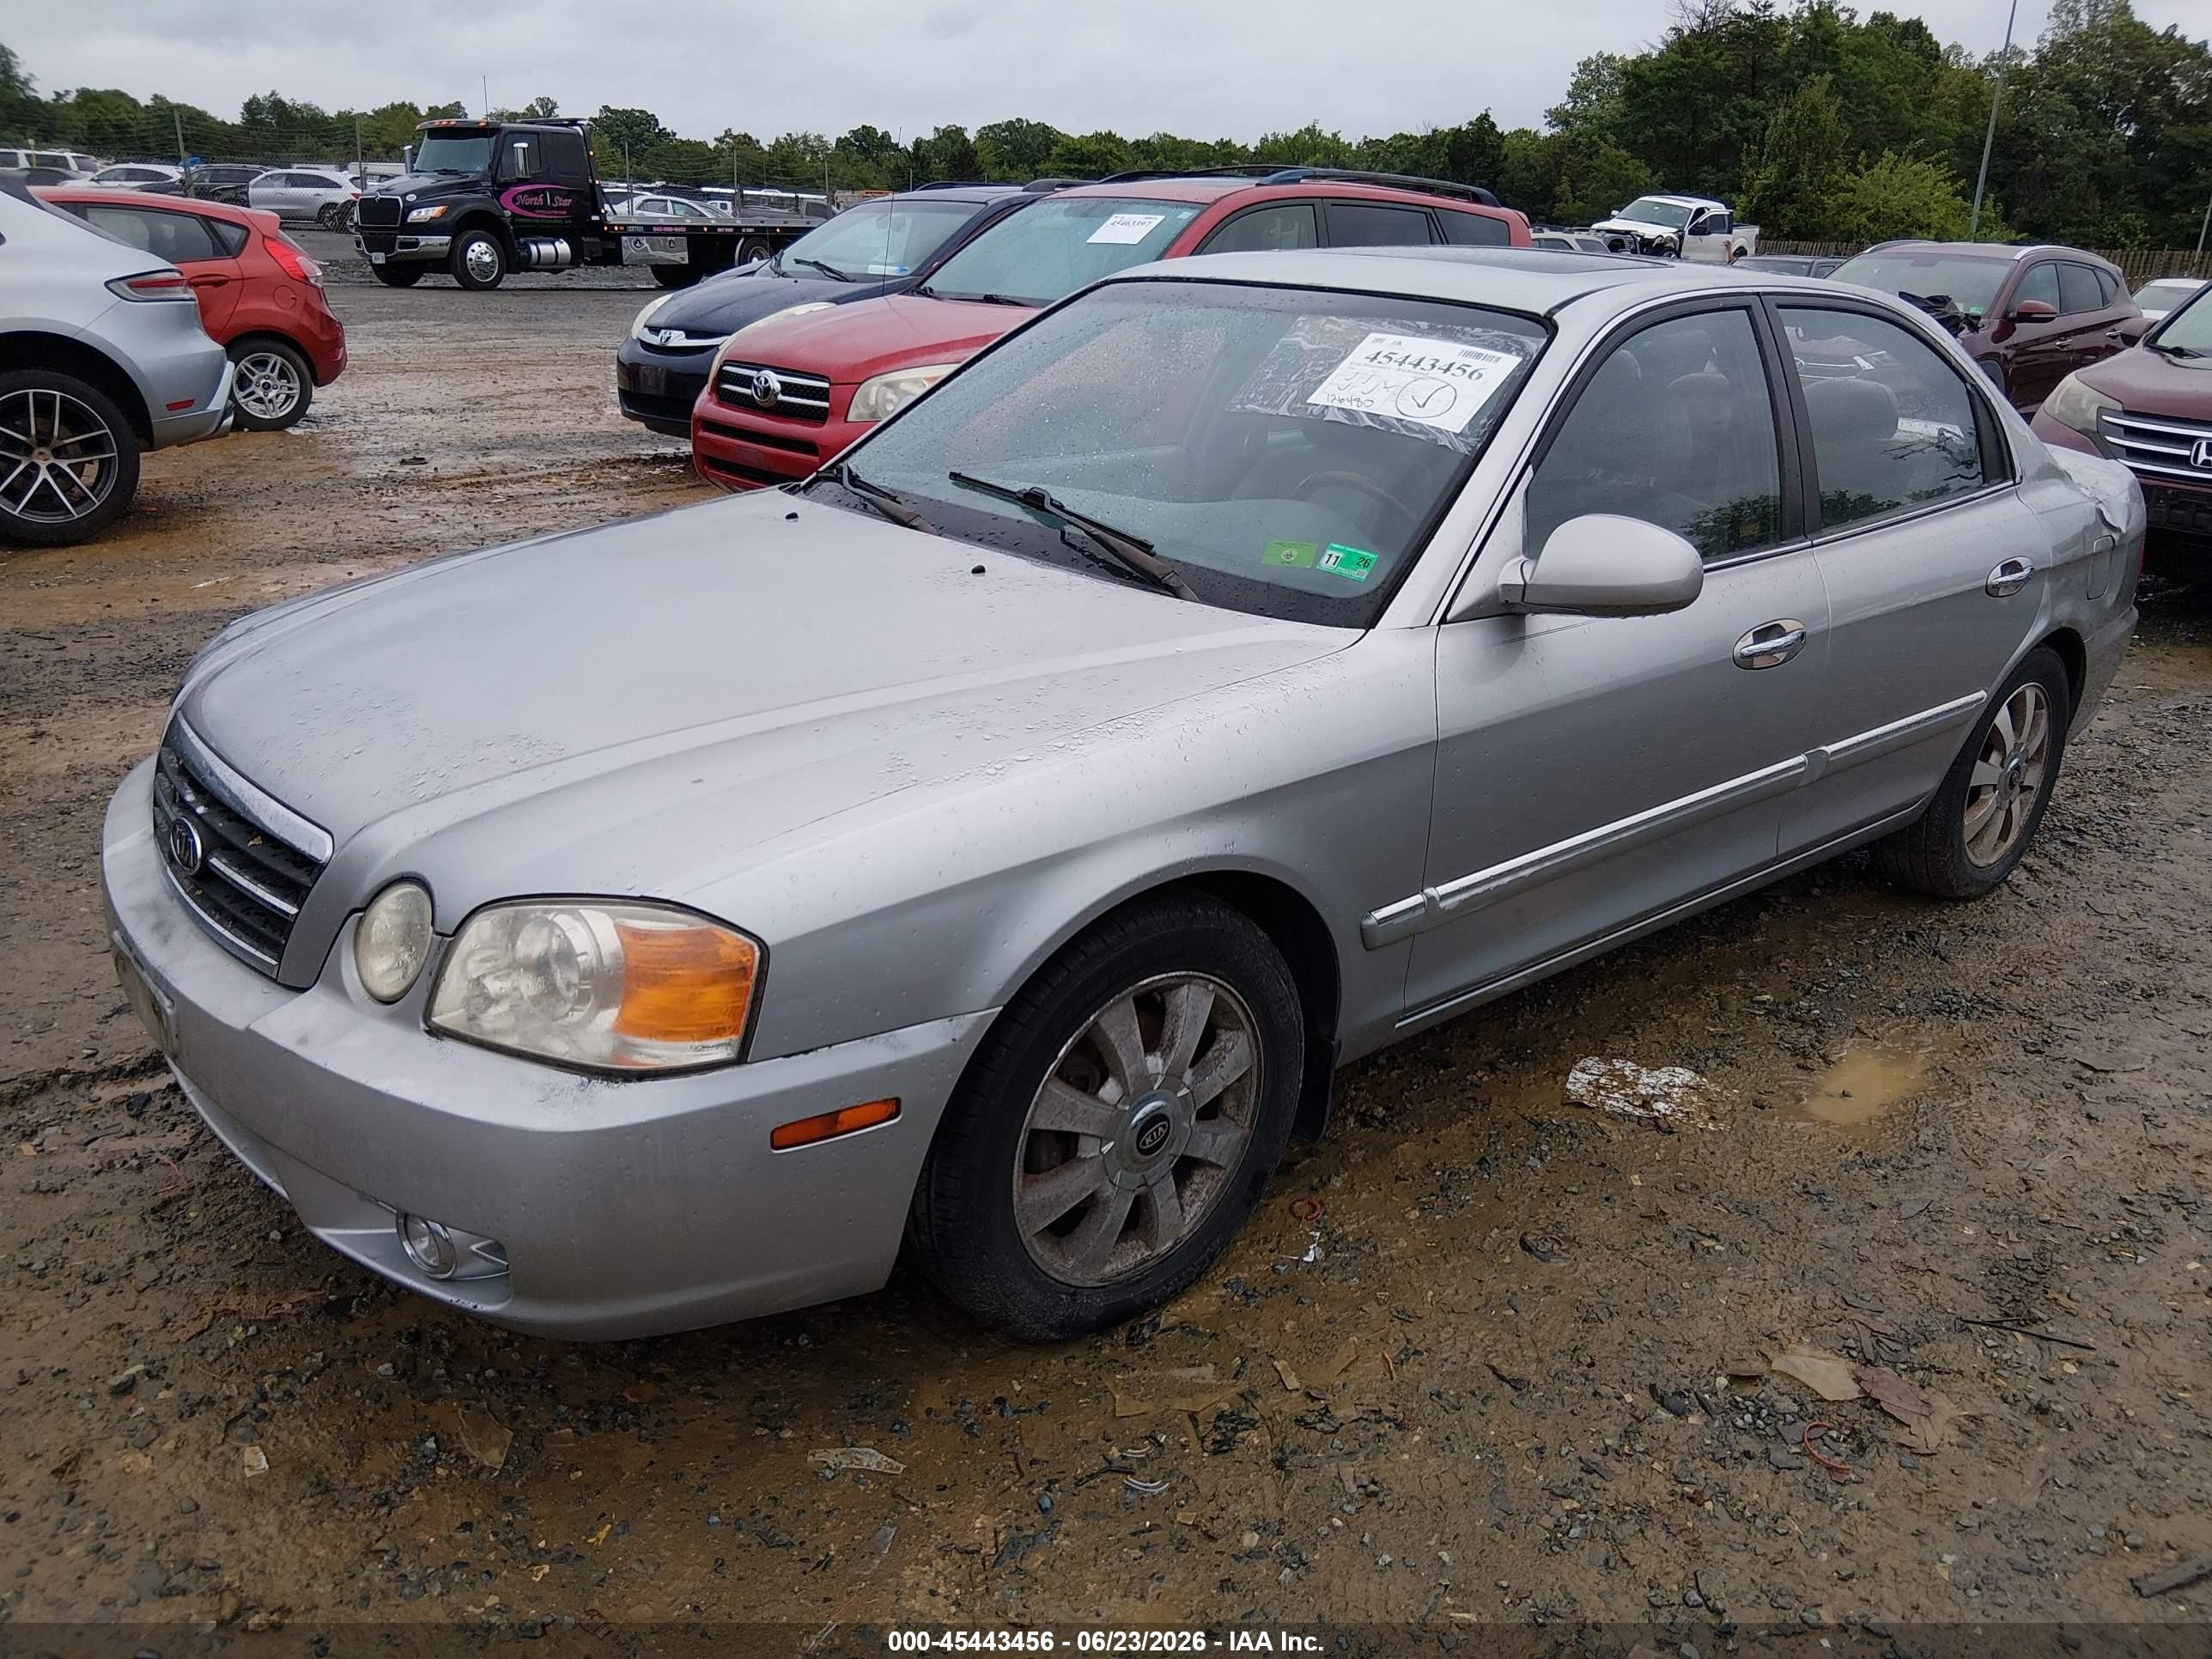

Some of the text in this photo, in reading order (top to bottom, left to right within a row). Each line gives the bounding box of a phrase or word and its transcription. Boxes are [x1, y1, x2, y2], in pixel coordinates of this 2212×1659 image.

[515, 194, 573, 206] North Star
[1364, 349, 1487, 381] 45443456
[1325, 553, 1340, 567] 11
[1356, 556, 1371, 568] 26
[1145, 1126, 1165, 1146] KIA
